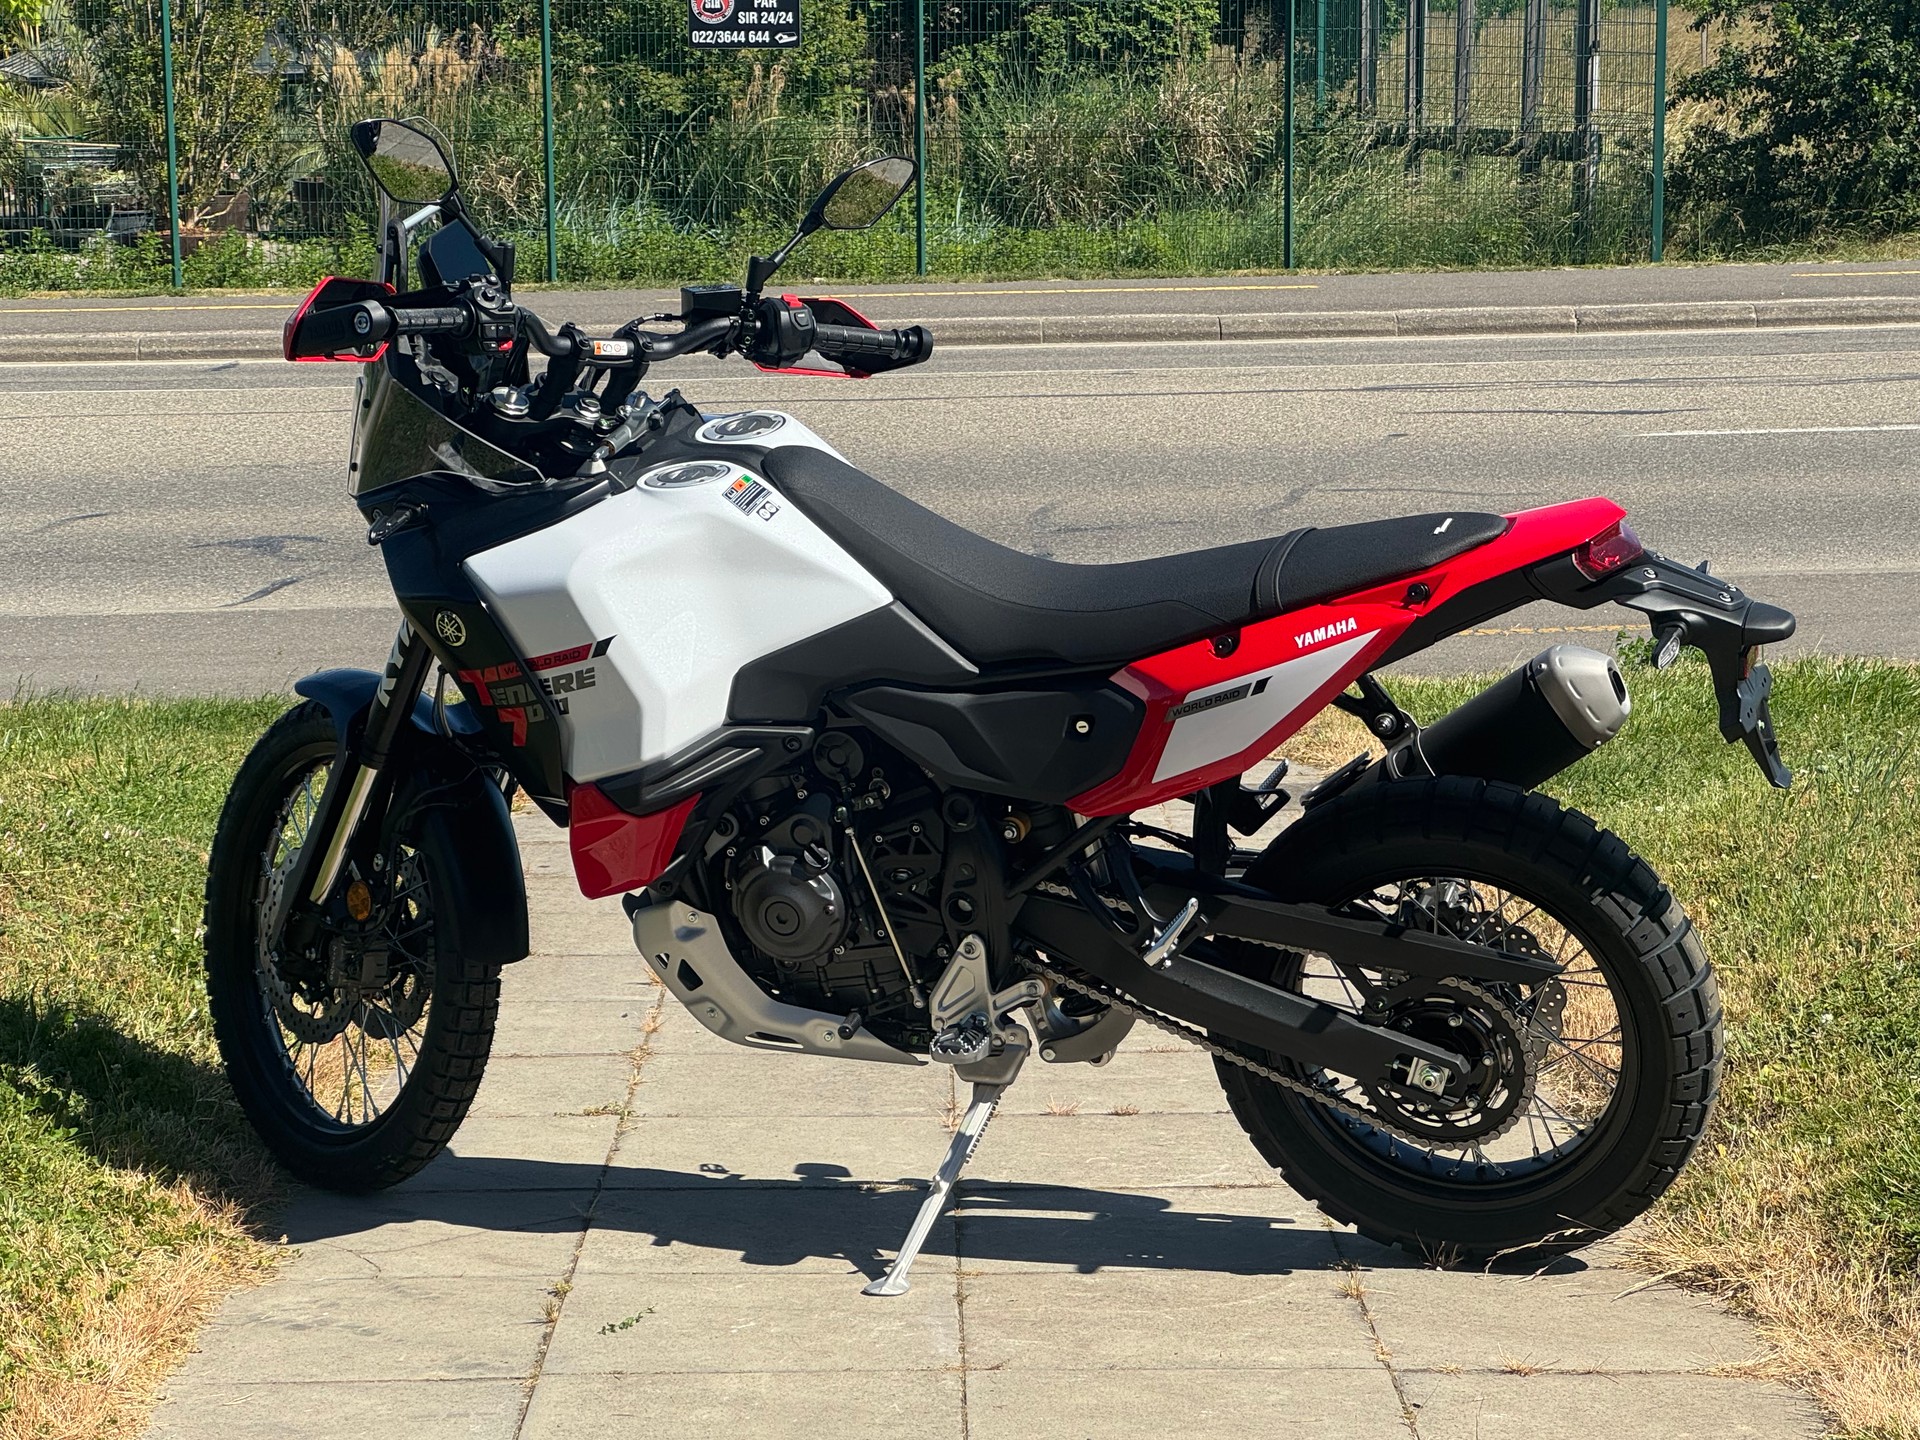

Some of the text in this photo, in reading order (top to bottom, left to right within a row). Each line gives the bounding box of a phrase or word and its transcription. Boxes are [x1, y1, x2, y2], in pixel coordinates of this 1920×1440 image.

[737, 11, 758, 24] SIR
[760, 11, 794, 25] 24/24
[692, 30, 770, 44] 022/3644 644
[1293, 616, 1358, 649] YAMAHA
[553, 650, 582, 664] RAID
[1172, 689, 1241, 718] WORLD RAID
